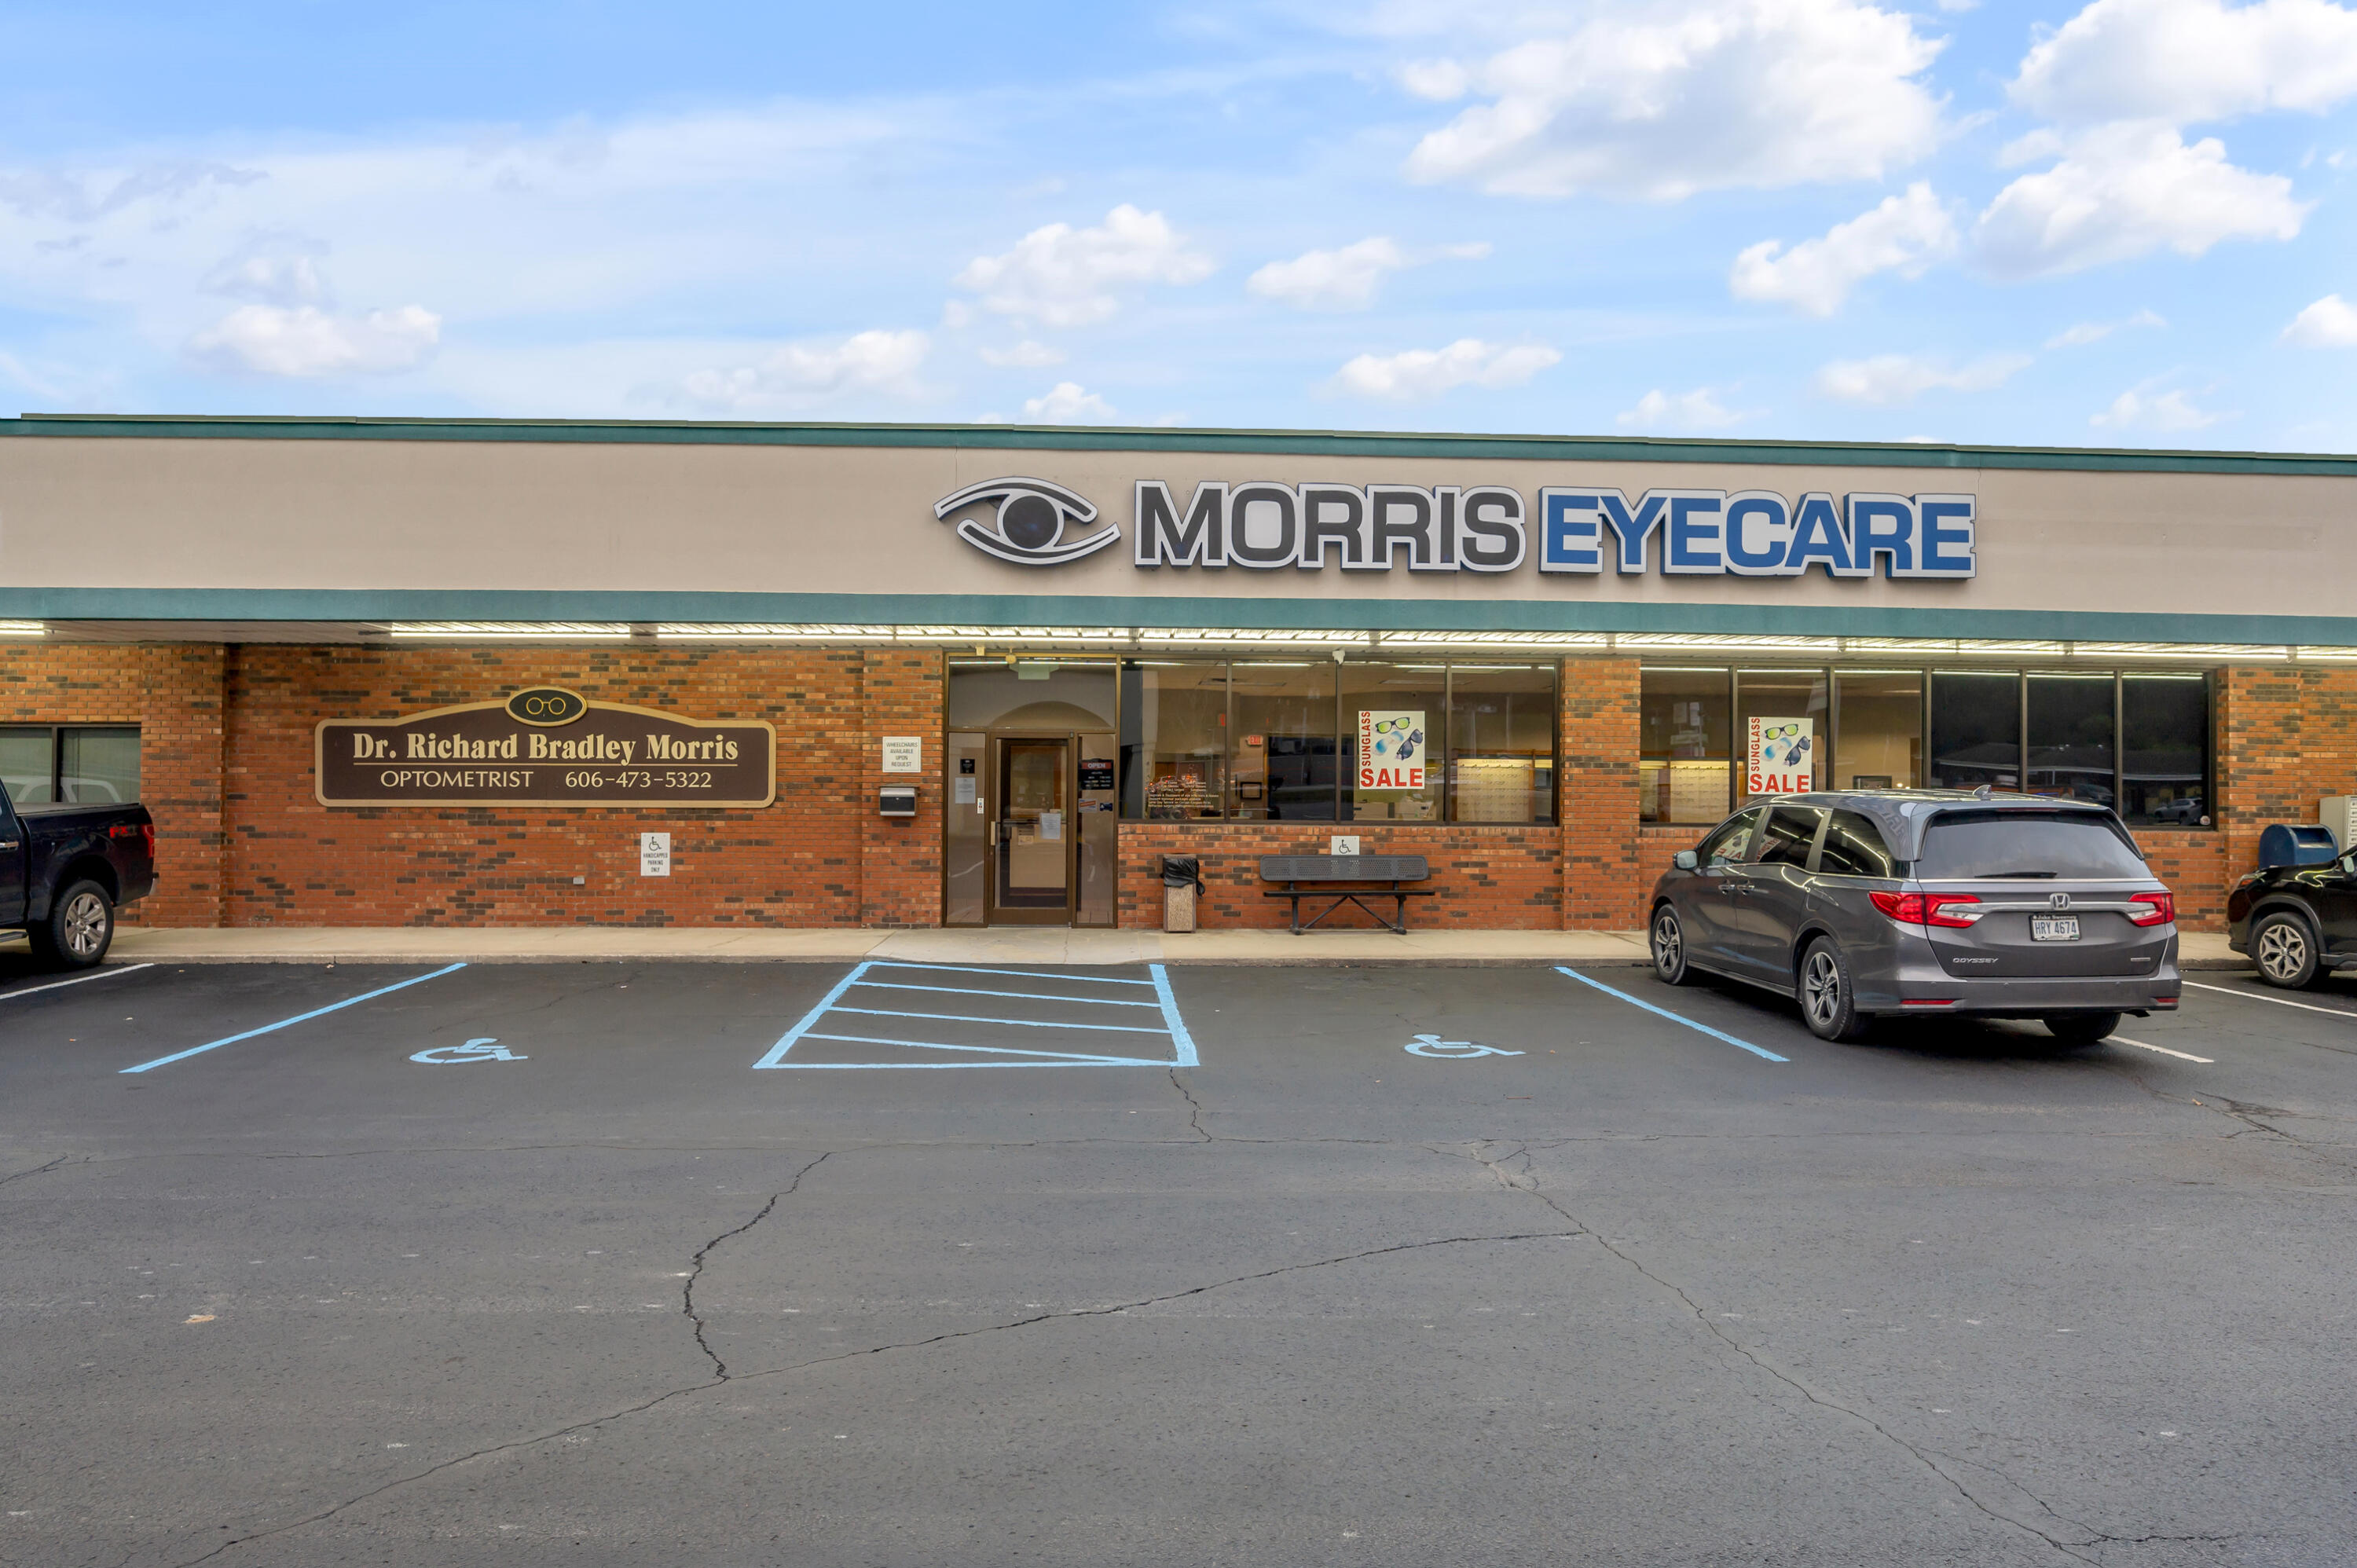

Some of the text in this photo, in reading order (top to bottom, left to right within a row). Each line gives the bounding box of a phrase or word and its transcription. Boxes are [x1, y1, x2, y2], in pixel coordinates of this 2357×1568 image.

[1135, 480, 1976, 578] MORRIS EYECARE
[353, 732, 739, 766] Dr. Richard Bradley Morris
[1362, 712, 1371, 766] SUNGLASS
[1751, 718, 1760, 771] SUNGLASS
[380, 771, 712, 788] OPTOMETRIST 606-473-5322
[1361, 768, 1423, 787] SALE
[1749, 773, 1810, 793] SALE
[2035, 921, 2077, 935] HRY 4674
